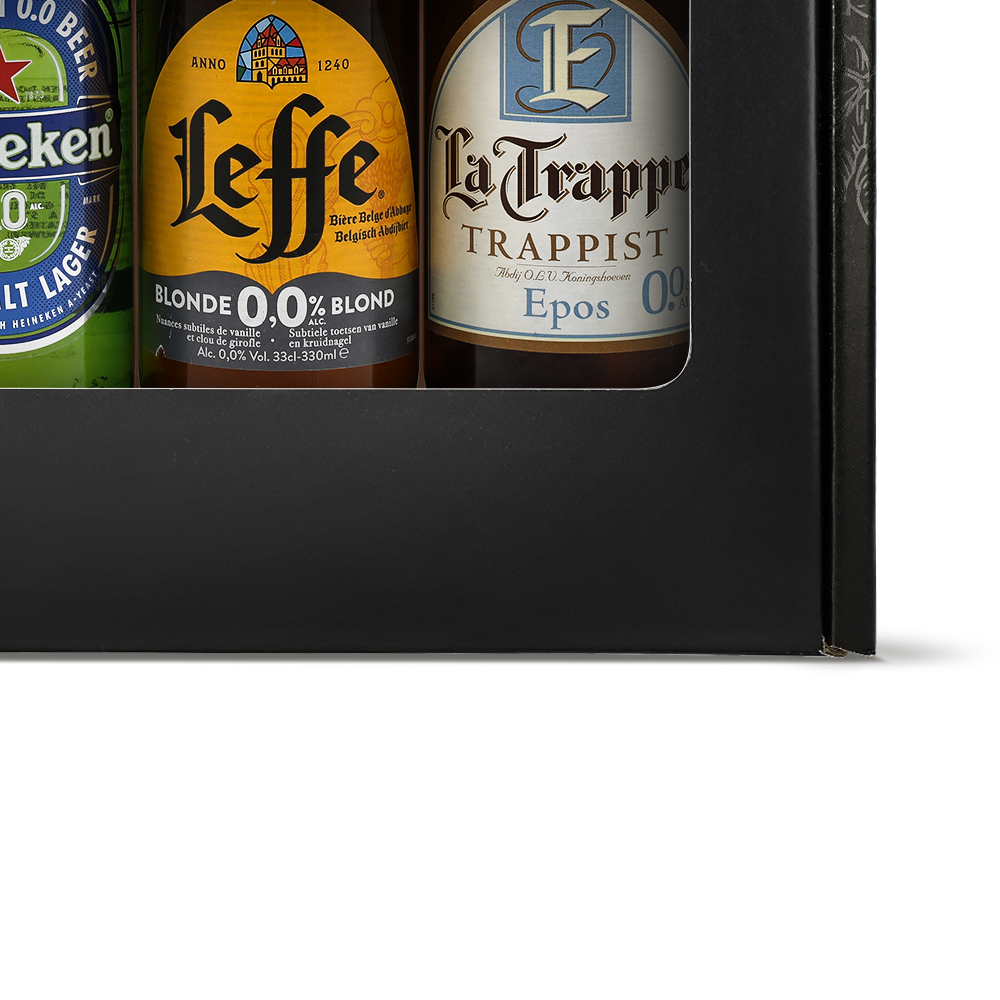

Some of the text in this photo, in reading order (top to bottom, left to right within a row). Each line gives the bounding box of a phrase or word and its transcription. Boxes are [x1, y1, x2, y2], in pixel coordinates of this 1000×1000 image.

[56, 11, 98, 82] BEER
[191, 56, 350, 72] ANNO 1240
[527, 5, 613, 113] E
[168, 93, 380, 264] Leffe
[434, 124, 689, 222] La Trappe
[30, 203, 44, 211] ALC.
[83, 194, 101, 205] MARK
[329, 214, 357, 226] Bière
[358, 209, 383, 223] Belge
[334, 220, 410, 243] Belgisch Abdijbier
[461, 224, 669, 262] TRAPPIST
[38, 226, 98, 299] LAGER
[494, 267, 522, 282] Abdij
[559, 270, 631, 285] Koningshoeven
[12, 306, 64, 329] HEINEKEN
[67, 271, 98, 308] A-YEAST
[155, 283, 232, 315] BLONDE
[331, 289, 395, 315] BLOND
[523, 287, 610, 330] Epos
[156, 314, 261, 338] Nuances subtiles de vanille
[289, 316, 399, 338] Subtiele toetsen van vanille
[308, 318, 326, 326] ALC.
[196, 336, 214, 344] clou
[216, 336, 227, 346] de
[229, 338, 261, 349] girofle
[288, 335, 352, 348] en kruidnagel
[197, 346, 216, 358] Alc.
[218, 348, 246, 362] 0,0%
[249, 350, 270, 362] Vol.
[273, 349, 337, 362] 33cl-330ml
